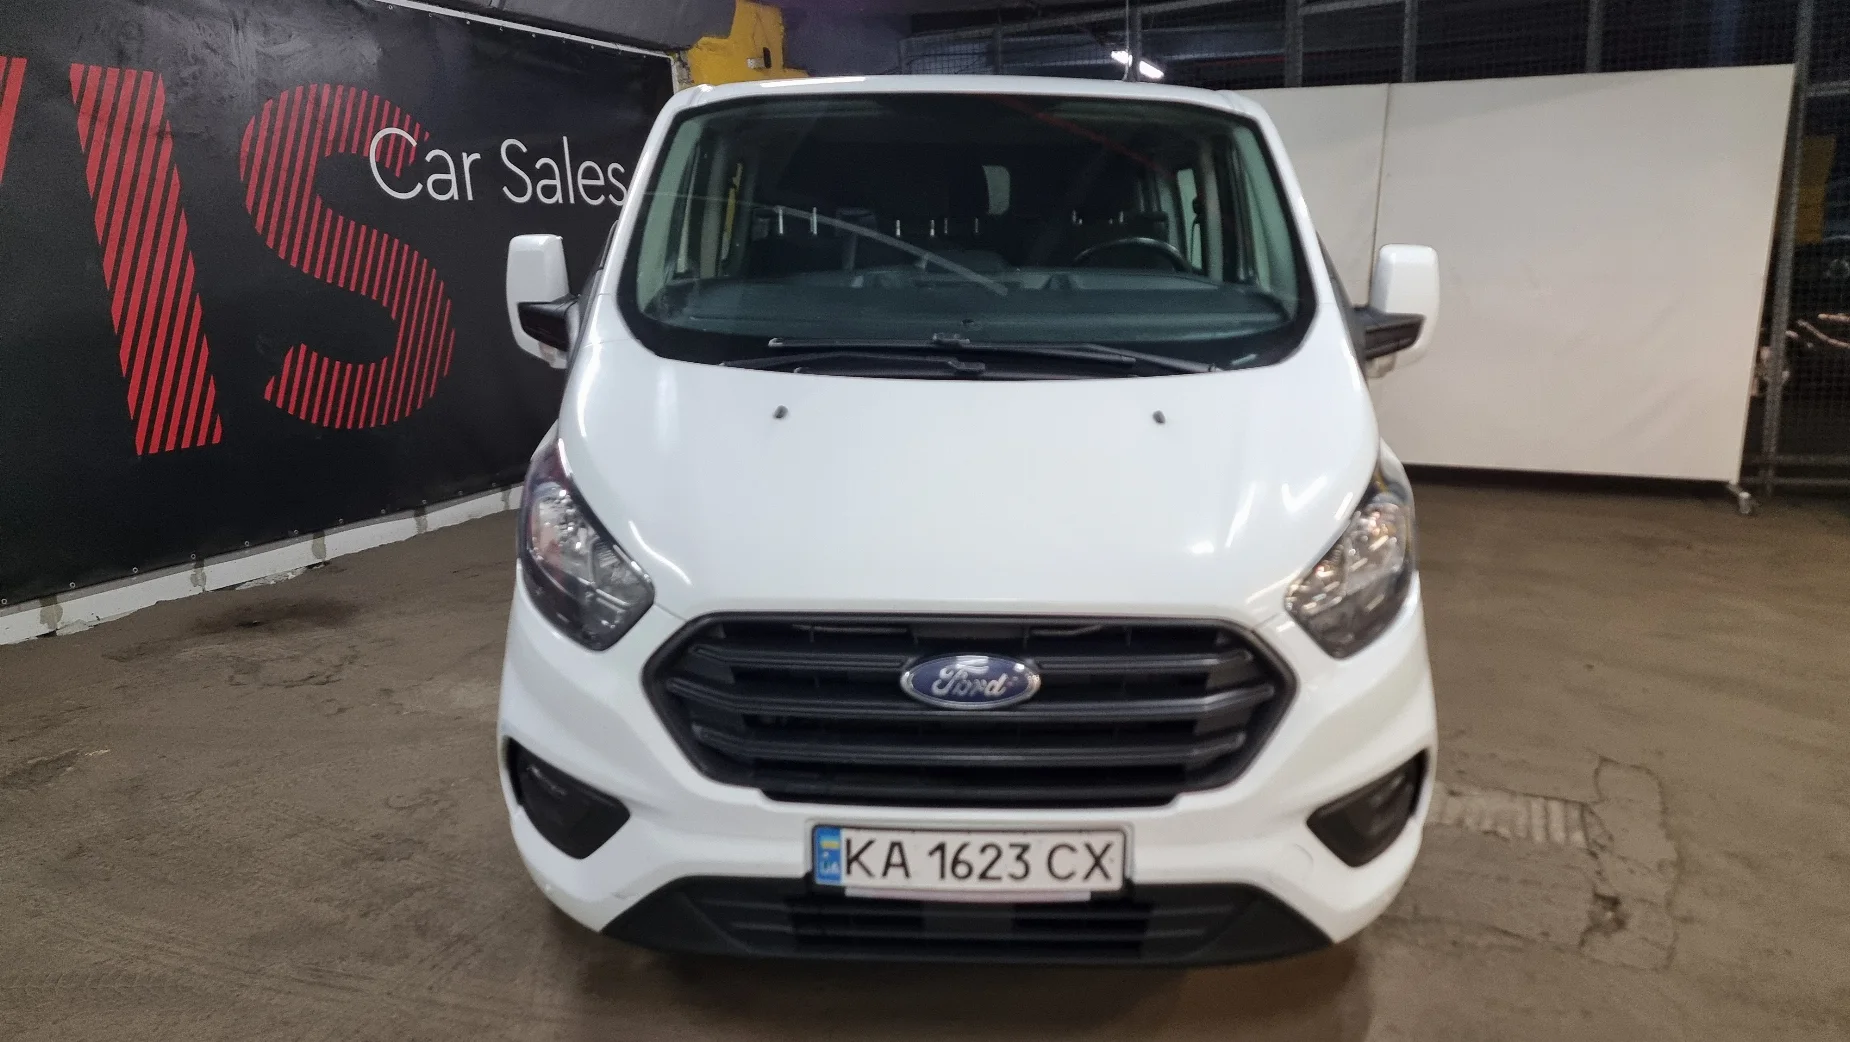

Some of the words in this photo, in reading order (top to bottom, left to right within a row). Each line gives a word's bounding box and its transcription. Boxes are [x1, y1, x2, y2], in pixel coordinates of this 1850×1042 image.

[369, 127, 481, 200] Car
[500, 135, 629, 206] Sales
[931, 662, 1009, 697] Ford
[846, 838, 911, 878] KA
[928, 842, 1031, 881] 1623
[1047, 843, 1113, 881] CX
